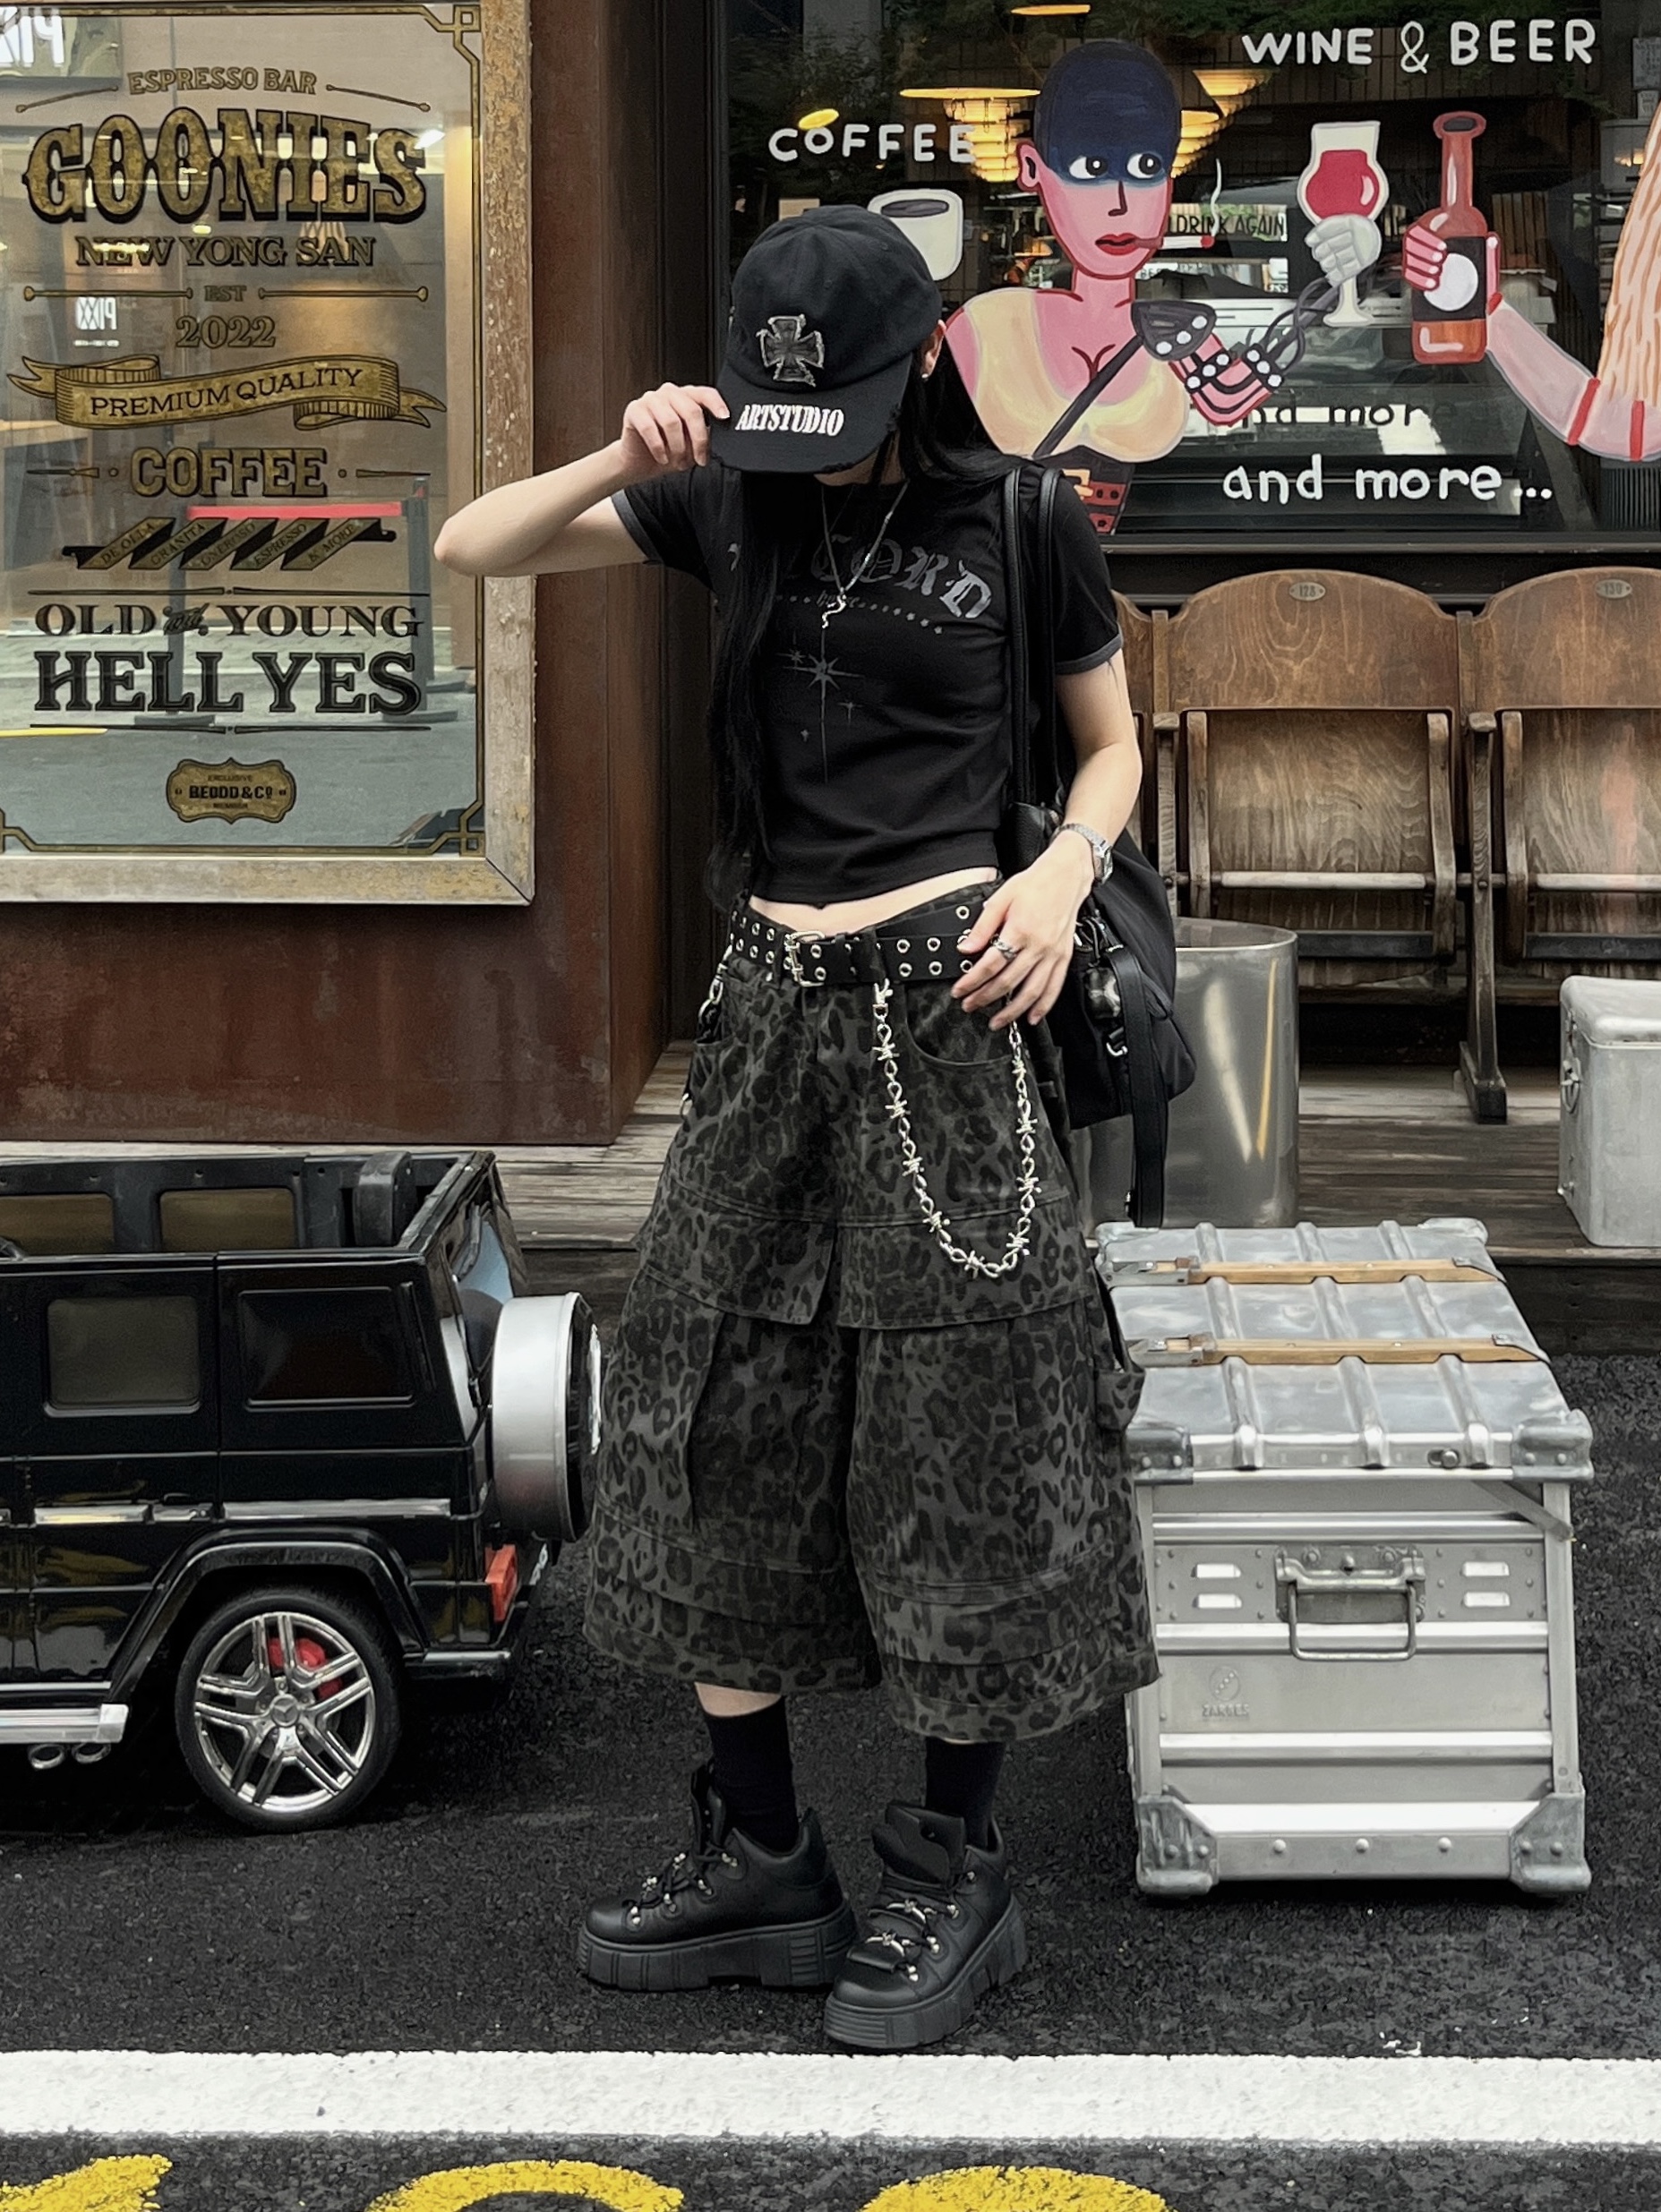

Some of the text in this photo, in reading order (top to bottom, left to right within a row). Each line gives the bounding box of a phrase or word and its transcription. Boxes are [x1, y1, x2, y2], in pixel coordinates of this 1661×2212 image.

[1242, 28, 1374, 65] WINE
[1400, 21, 1430, 73] &
[1450, 19, 1597, 65] BEER
[127, 67, 317, 95] ESPRESSO BAR
[768, 124, 976, 163] COFFEE
[21, 107, 427, 224] GOONIES
[1235, 214, 1285, 235] AGAIN
[74, 236, 375, 267] NEW YONG SAN
[204, 285, 246, 302] EST
[176, 316, 276, 348] 2022
[90, 367, 363, 417] PREMIUM QUALITY
[735, 404, 844, 437] ARTSTUDIO
[130, 448, 327, 498] COFFEE
[1223, 453, 1324, 504] and
[35, 602, 156, 636] OLD
[216, 605, 424, 637] YOUNG
[34, 651, 422, 715] HELL YES
